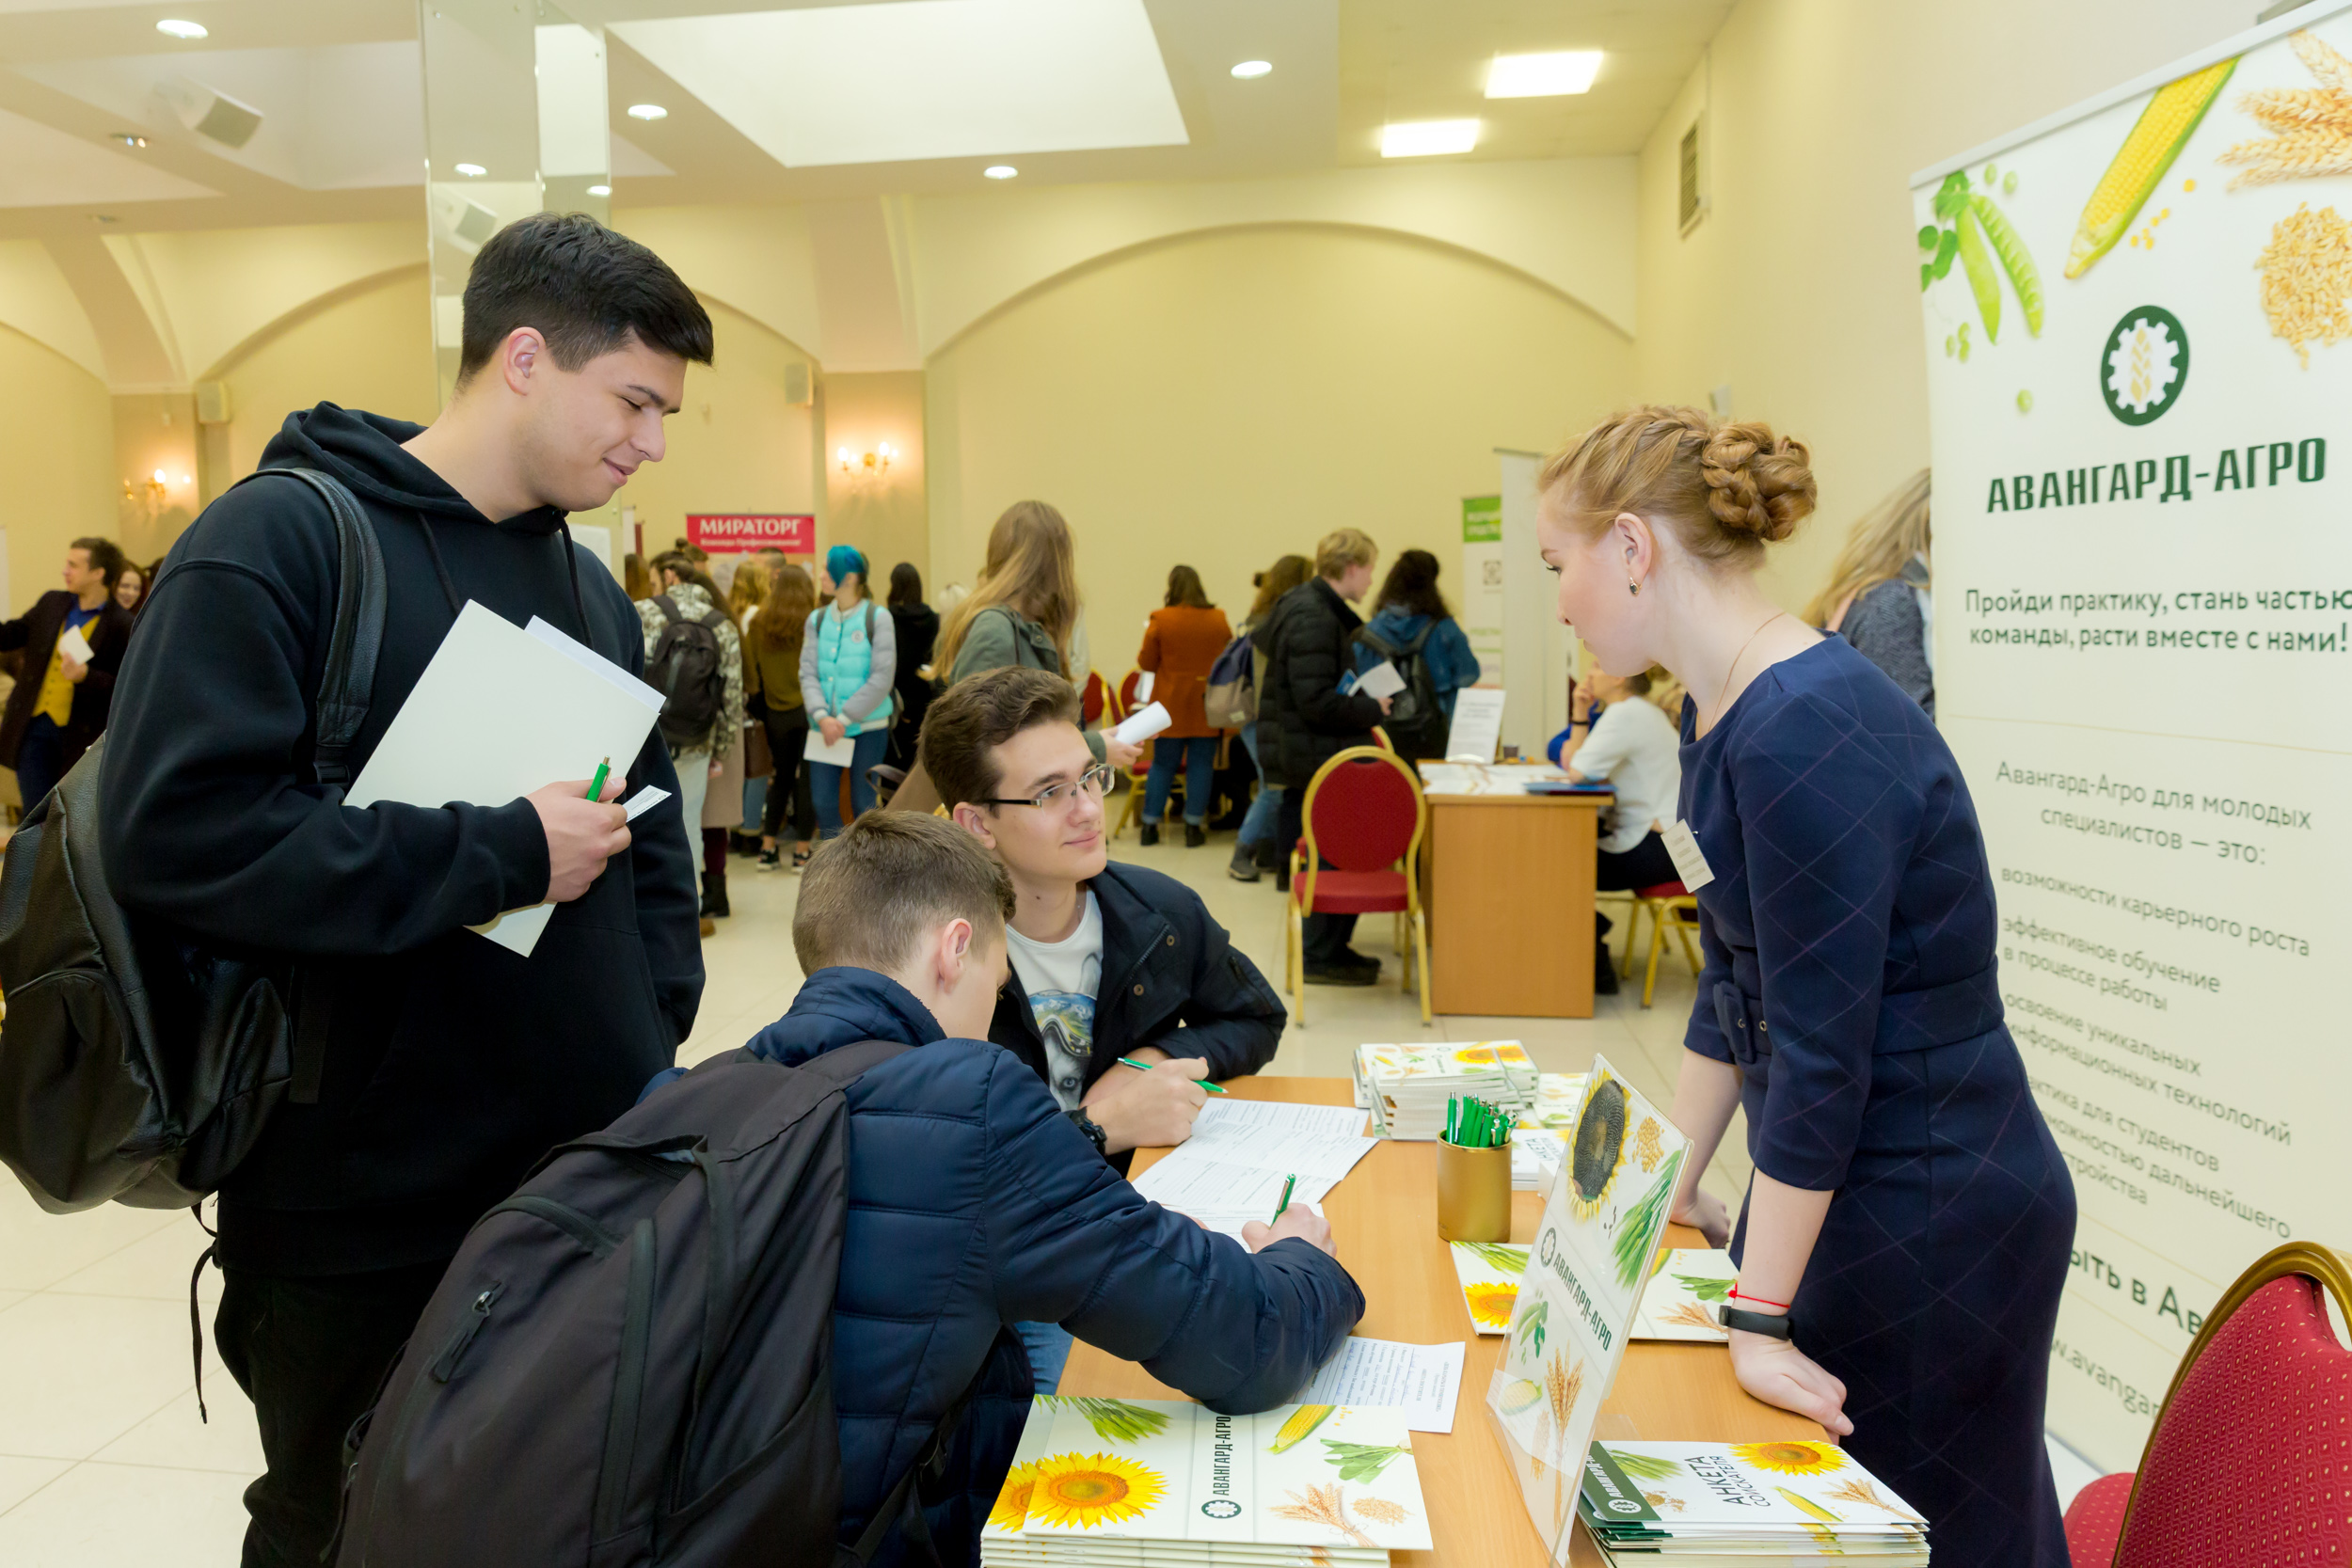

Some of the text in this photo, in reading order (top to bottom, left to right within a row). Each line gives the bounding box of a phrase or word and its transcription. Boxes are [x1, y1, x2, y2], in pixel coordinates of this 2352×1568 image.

[1986, 437, 2327, 514] АВАНГАРД-АГРО
[699, 518, 802, 535] МИРАТОРГ
[1966, 589, 2053, 617] Пройди
[2060, 593, 2168, 617] практику,
[2175, 591, 2249, 610] стань
[1970, 622, 2347, 652] команды, расти вместе с нами!
[1995, 761, 2312, 830] Авангард-Агро для молодых
[2041, 809, 2184, 849] специалистов
[2217, 840, 2266, 866] это:
[2001, 867, 2311, 958] возможности карьерного роста
[2002, 914, 2222, 993] эффективное обучение
[2003, 946, 2169, 1012] в процессе работы
[2005, 992, 2202, 1077] освоение уникальных
[2082, 1101, 2113, 1126] для
[2118, 1116, 2220, 1172] студентов
[2163, 1083, 2293, 1147] технологий
[2148, 1162, 2292, 1240] дальнейшего
[1552, 1252, 1613, 1352] АВАНГАРД-АГРО
[2132, 1277, 2147, 1306] в
[1213, 1416, 1233, 1497] АВАНГАРД-АГРО
[1684, 1455, 1753, 1507] АНКЕТА
[1708, 1455, 1772, 1508] СОИСКАТЕЛЯ
